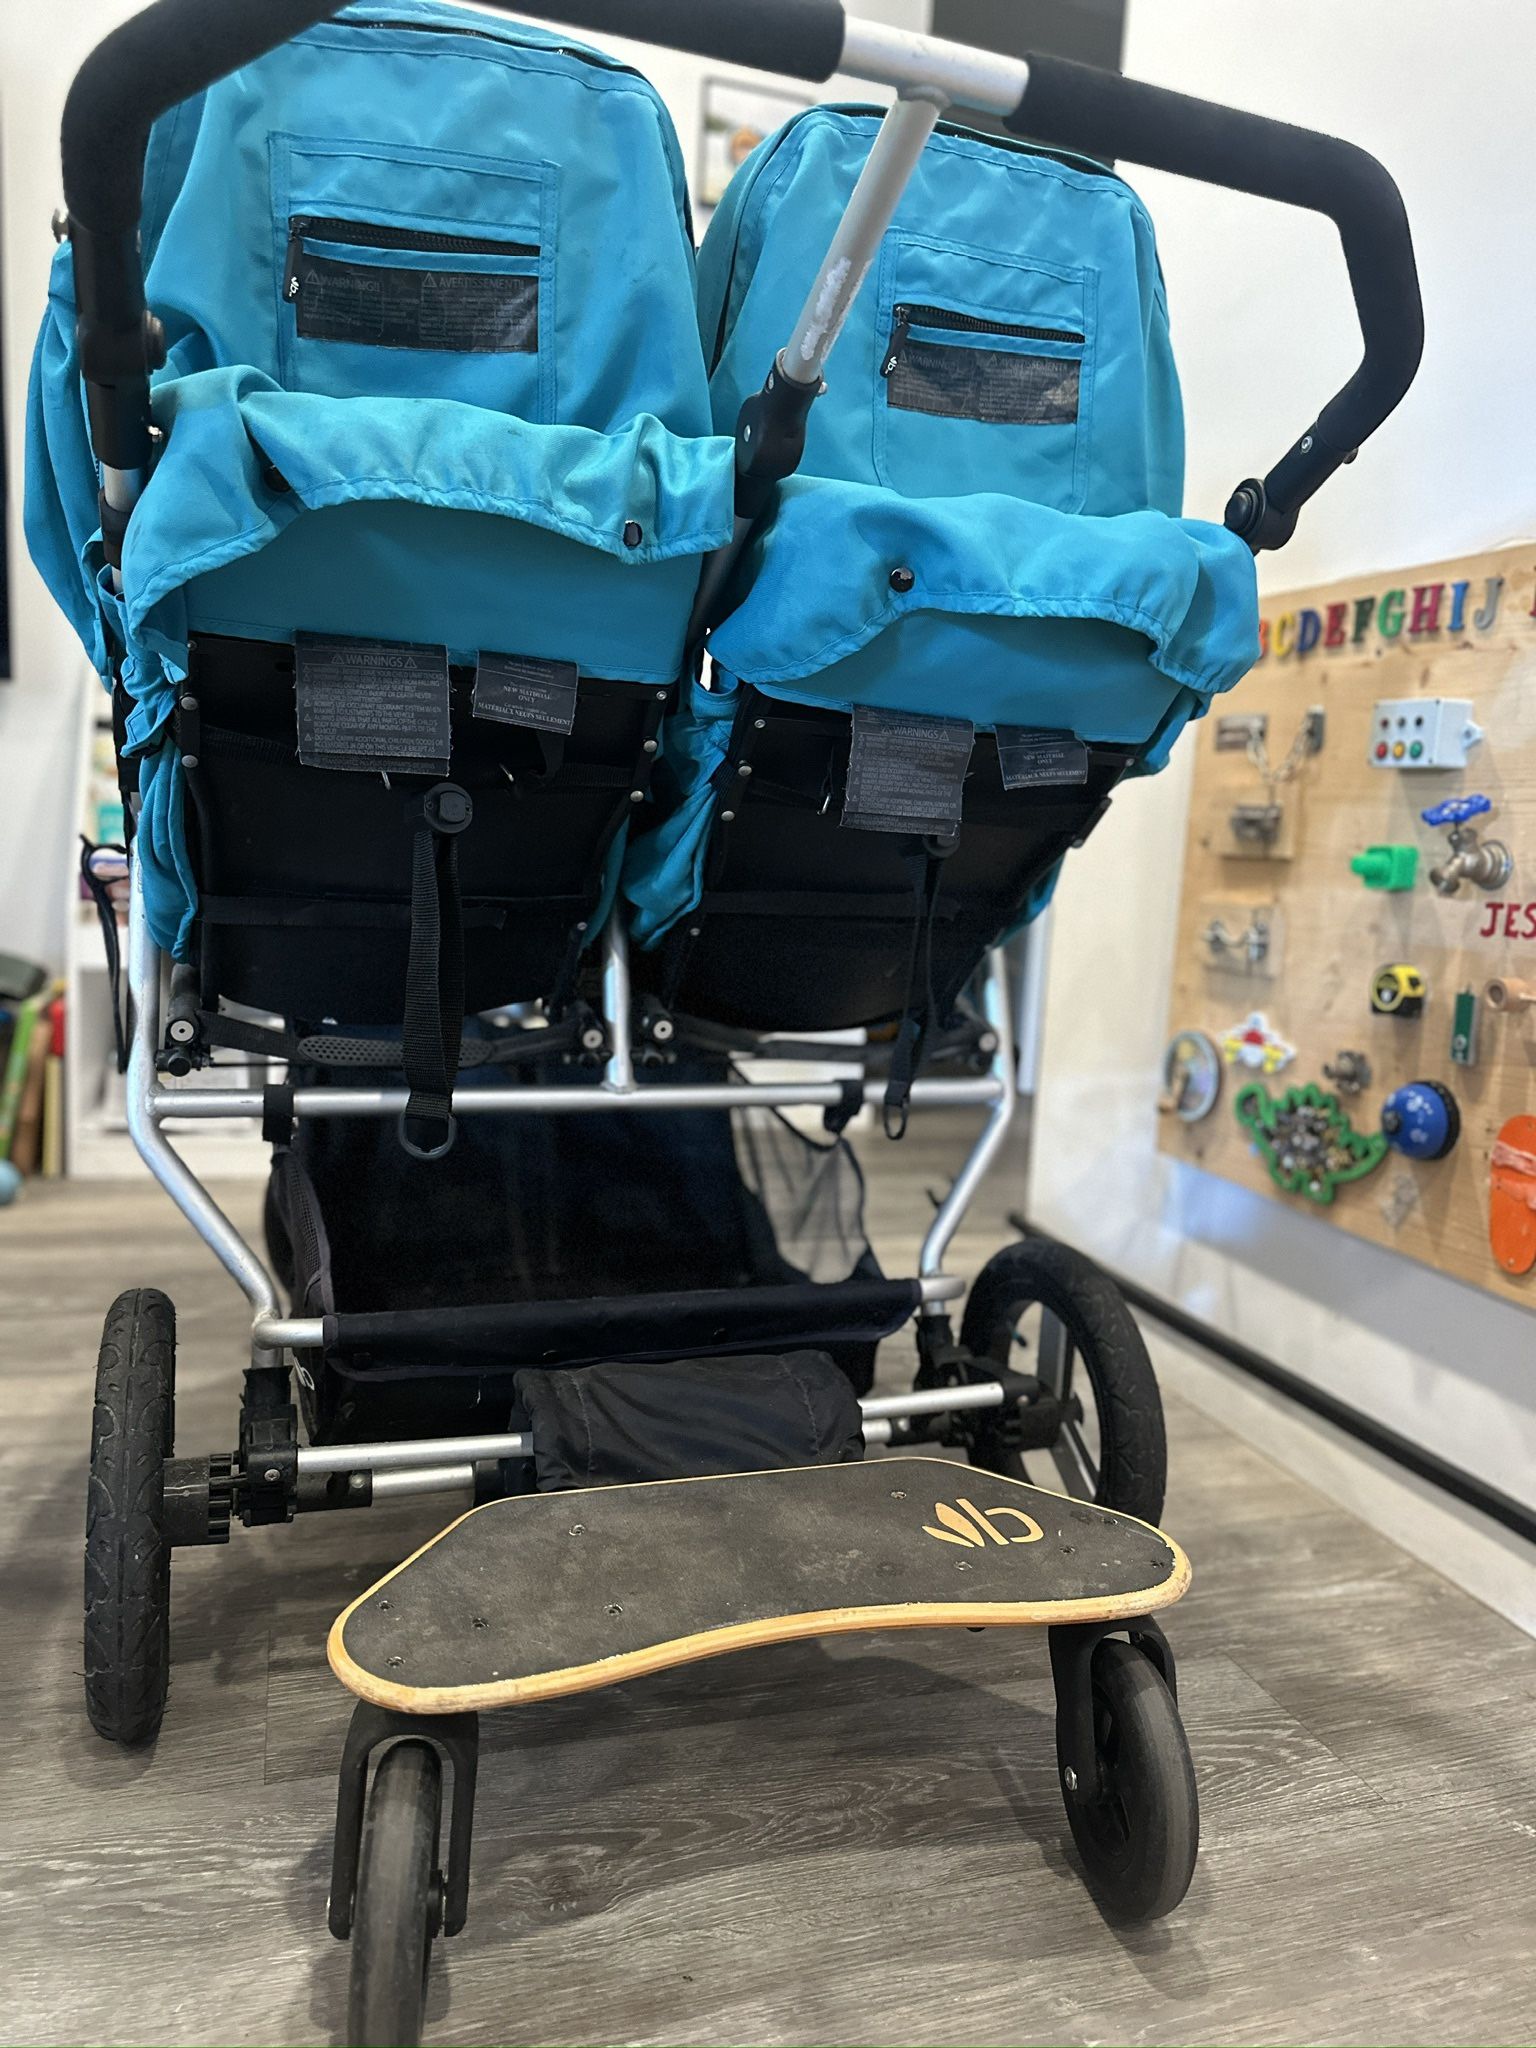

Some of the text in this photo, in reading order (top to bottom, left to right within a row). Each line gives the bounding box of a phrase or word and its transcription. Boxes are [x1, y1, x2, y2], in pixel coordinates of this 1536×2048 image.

[346, 654, 403, 668] WARNINGS
[894, 726, 939, 739] WARNINGS
[1480, 901, 1536, 940] JES
